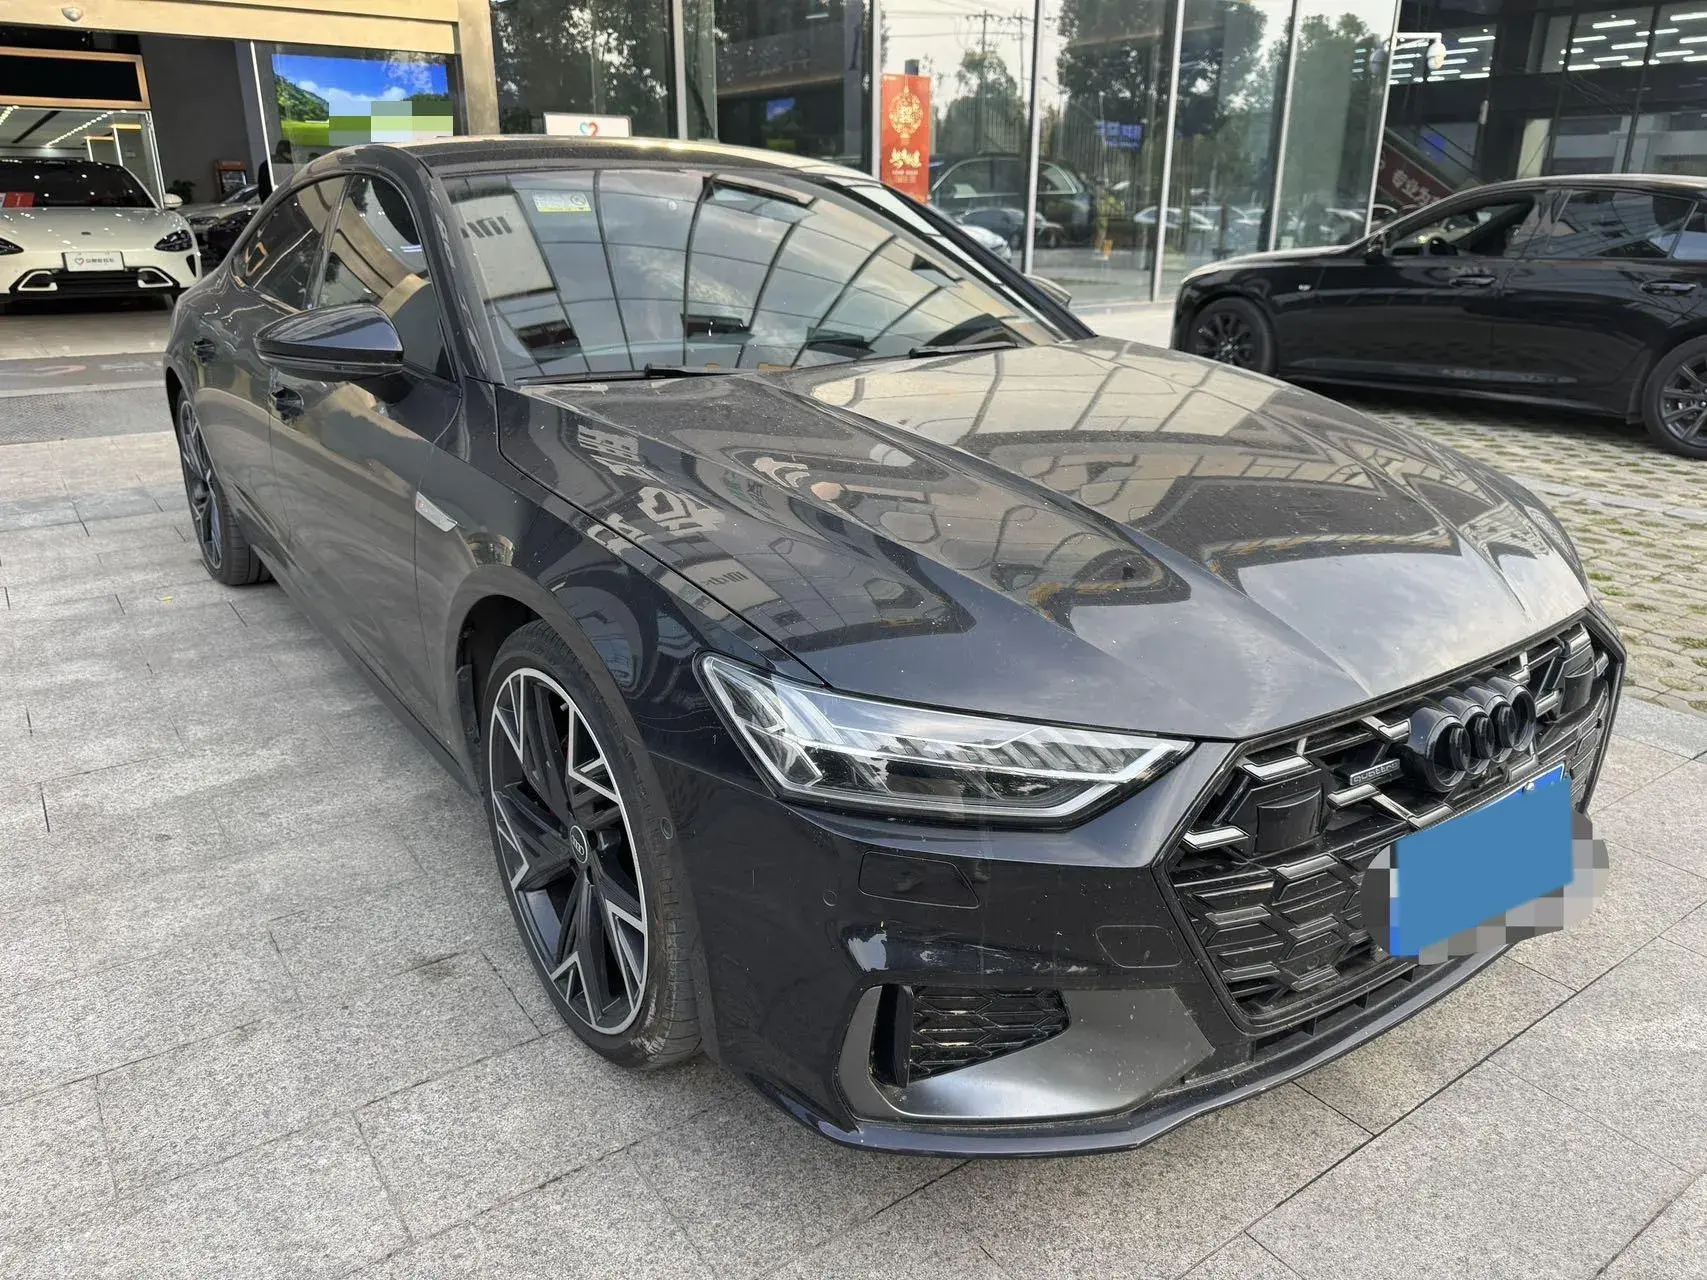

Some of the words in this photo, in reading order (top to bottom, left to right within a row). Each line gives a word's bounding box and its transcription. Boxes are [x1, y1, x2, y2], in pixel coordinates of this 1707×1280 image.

[1392, 169, 1440, 204] 专业为
[1353, 762, 1399, 783] quattro
